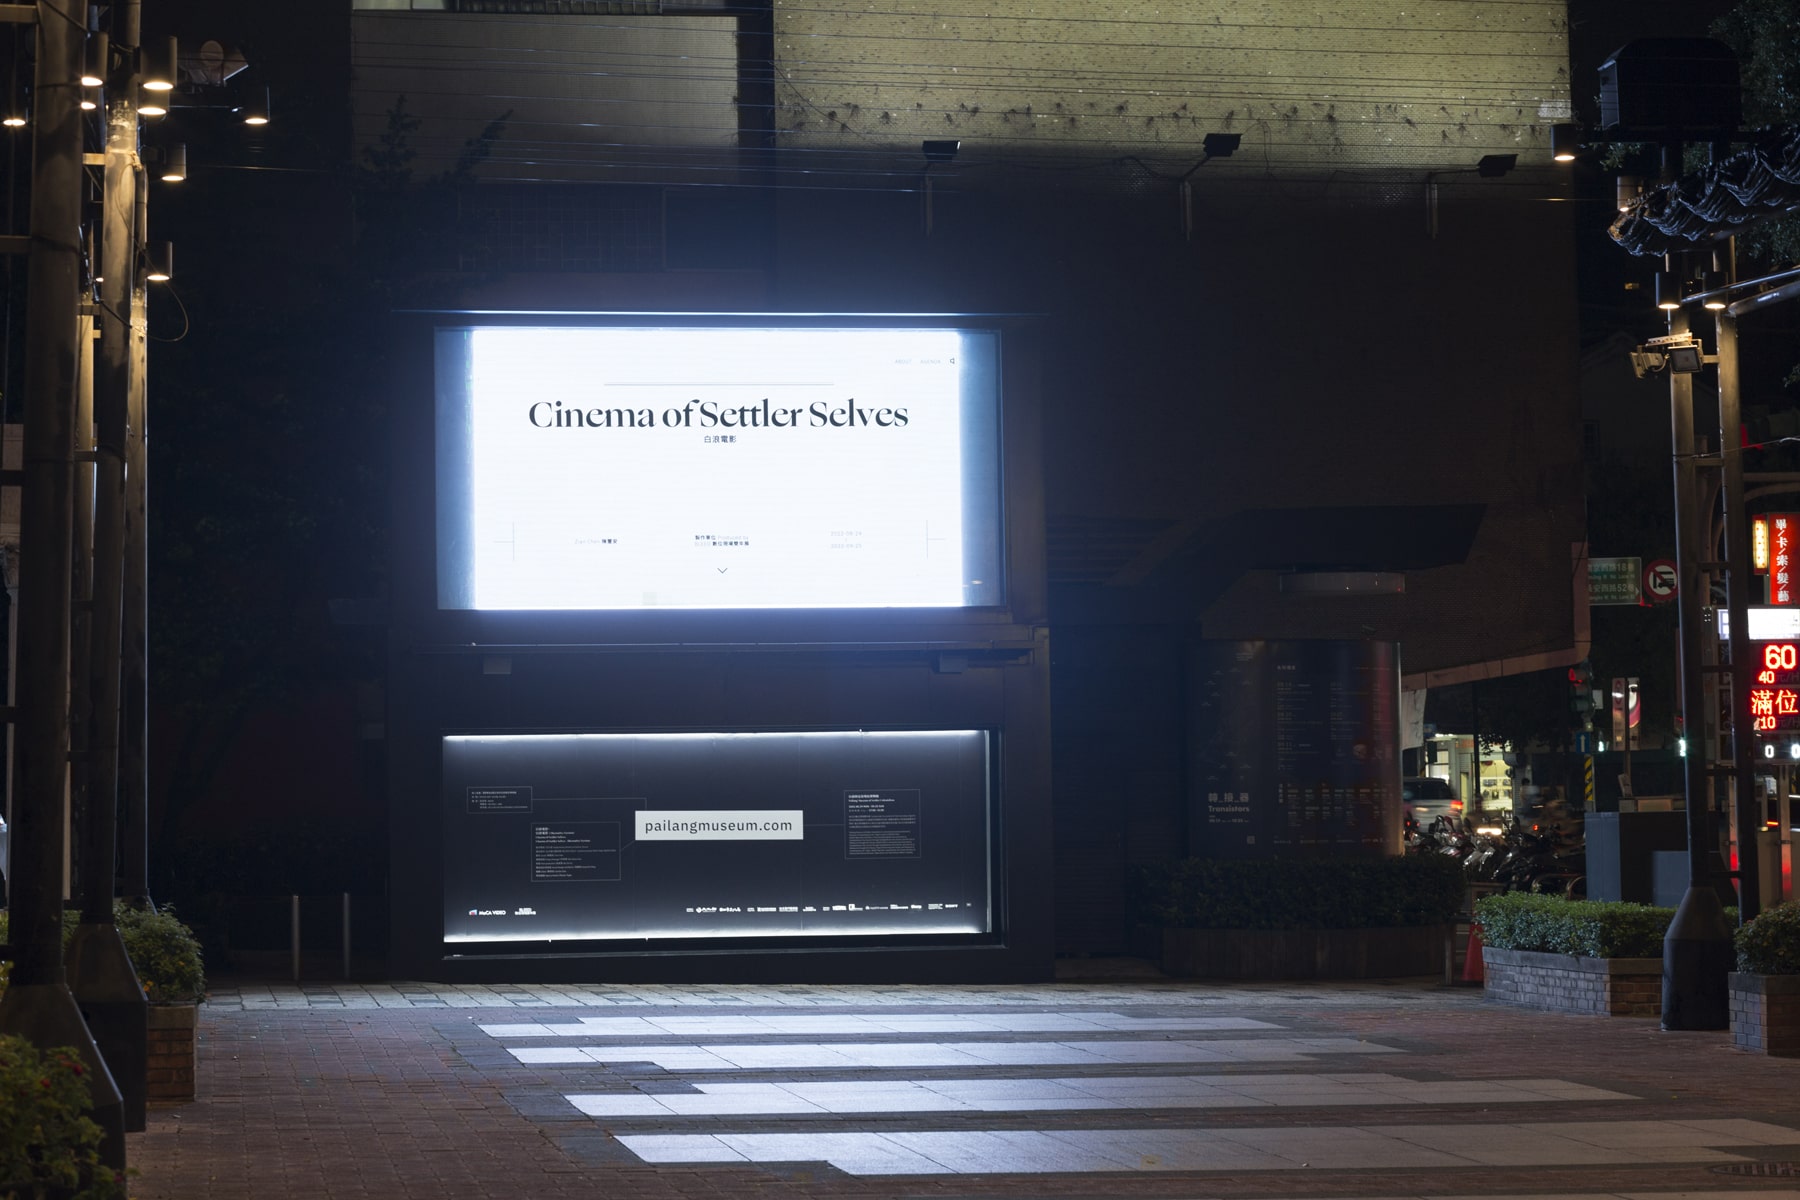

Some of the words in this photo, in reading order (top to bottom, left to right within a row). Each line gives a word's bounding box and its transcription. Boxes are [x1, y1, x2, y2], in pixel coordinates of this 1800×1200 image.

[529, 401, 655, 428] Cinema
[662, 398, 700, 428] of
[700, 397, 804, 428] Settler
[810, 397, 909, 428] Selves
[704, 435, 737, 444] 白浪電影
[1765, 645, 1797, 670] 60
[1759, 671, 1775, 684] 40
[1752, 690, 1799, 715] 滿位
[645, 819, 792, 834] pailangmuseum.com
